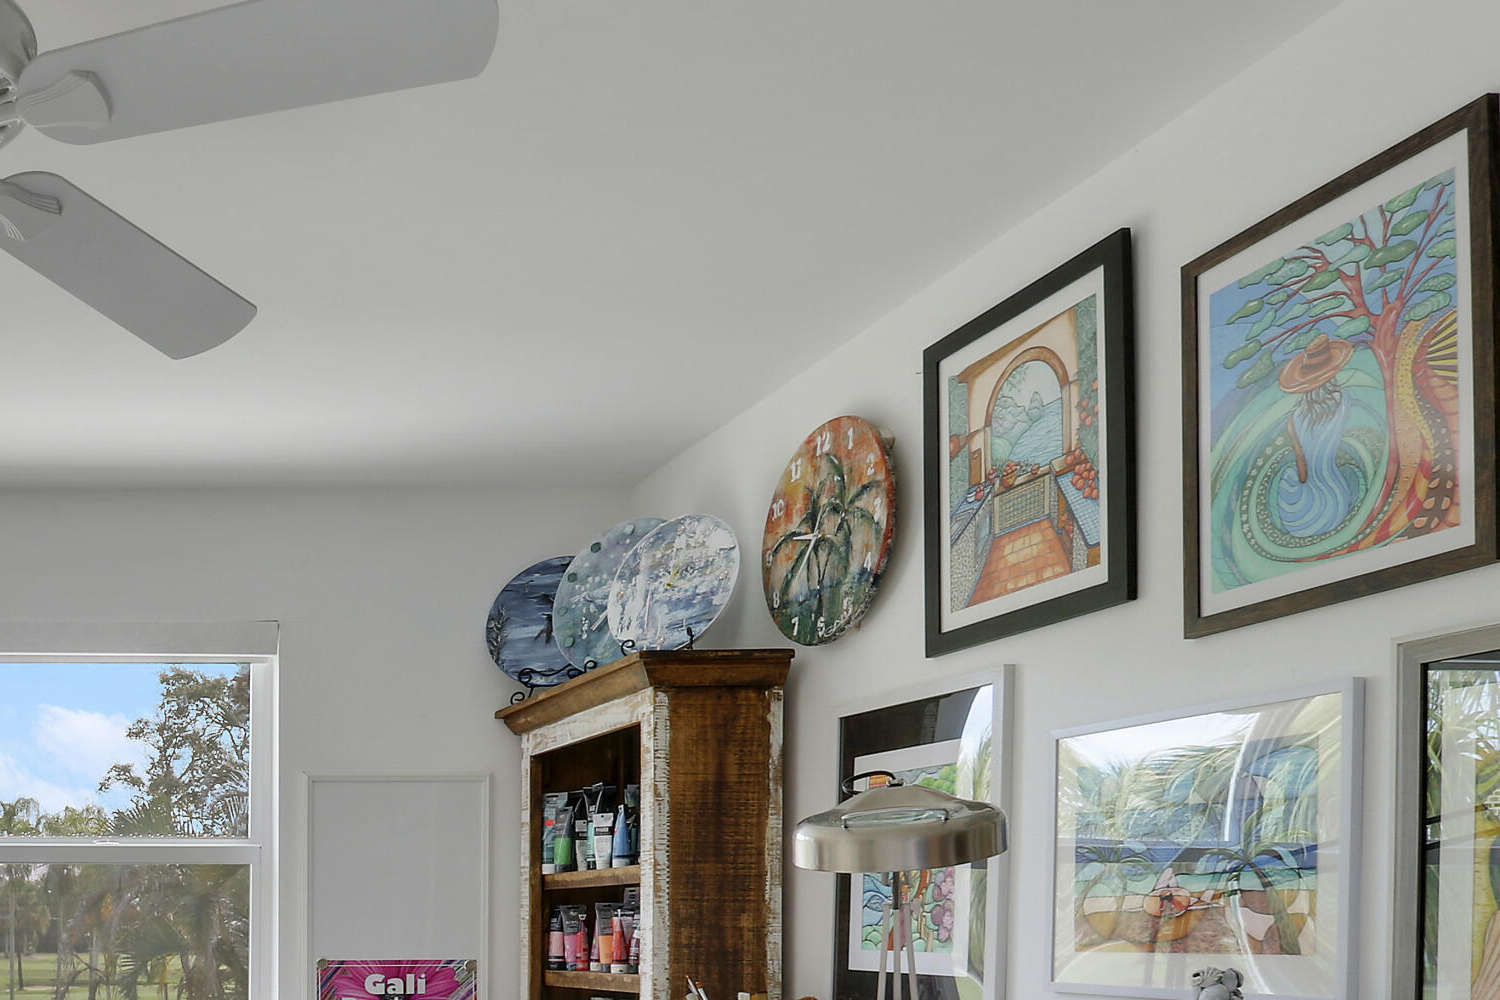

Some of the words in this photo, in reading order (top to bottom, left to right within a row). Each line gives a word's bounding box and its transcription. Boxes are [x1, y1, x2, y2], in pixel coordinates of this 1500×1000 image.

[815, 431, 831, 457] 12
[847, 427, 854, 450] 1
[790, 457, 802, 484] 11
[866, 452, 876, 476] 2
[771, 498, 786, 522] 10
[765, 550, 773, 567] 9
[863, 551, 872, 571] 4
[772, 590, 781, 609] 8
[790, 616, 799, 636] 7
[364, 972, 427, 995] Gali
